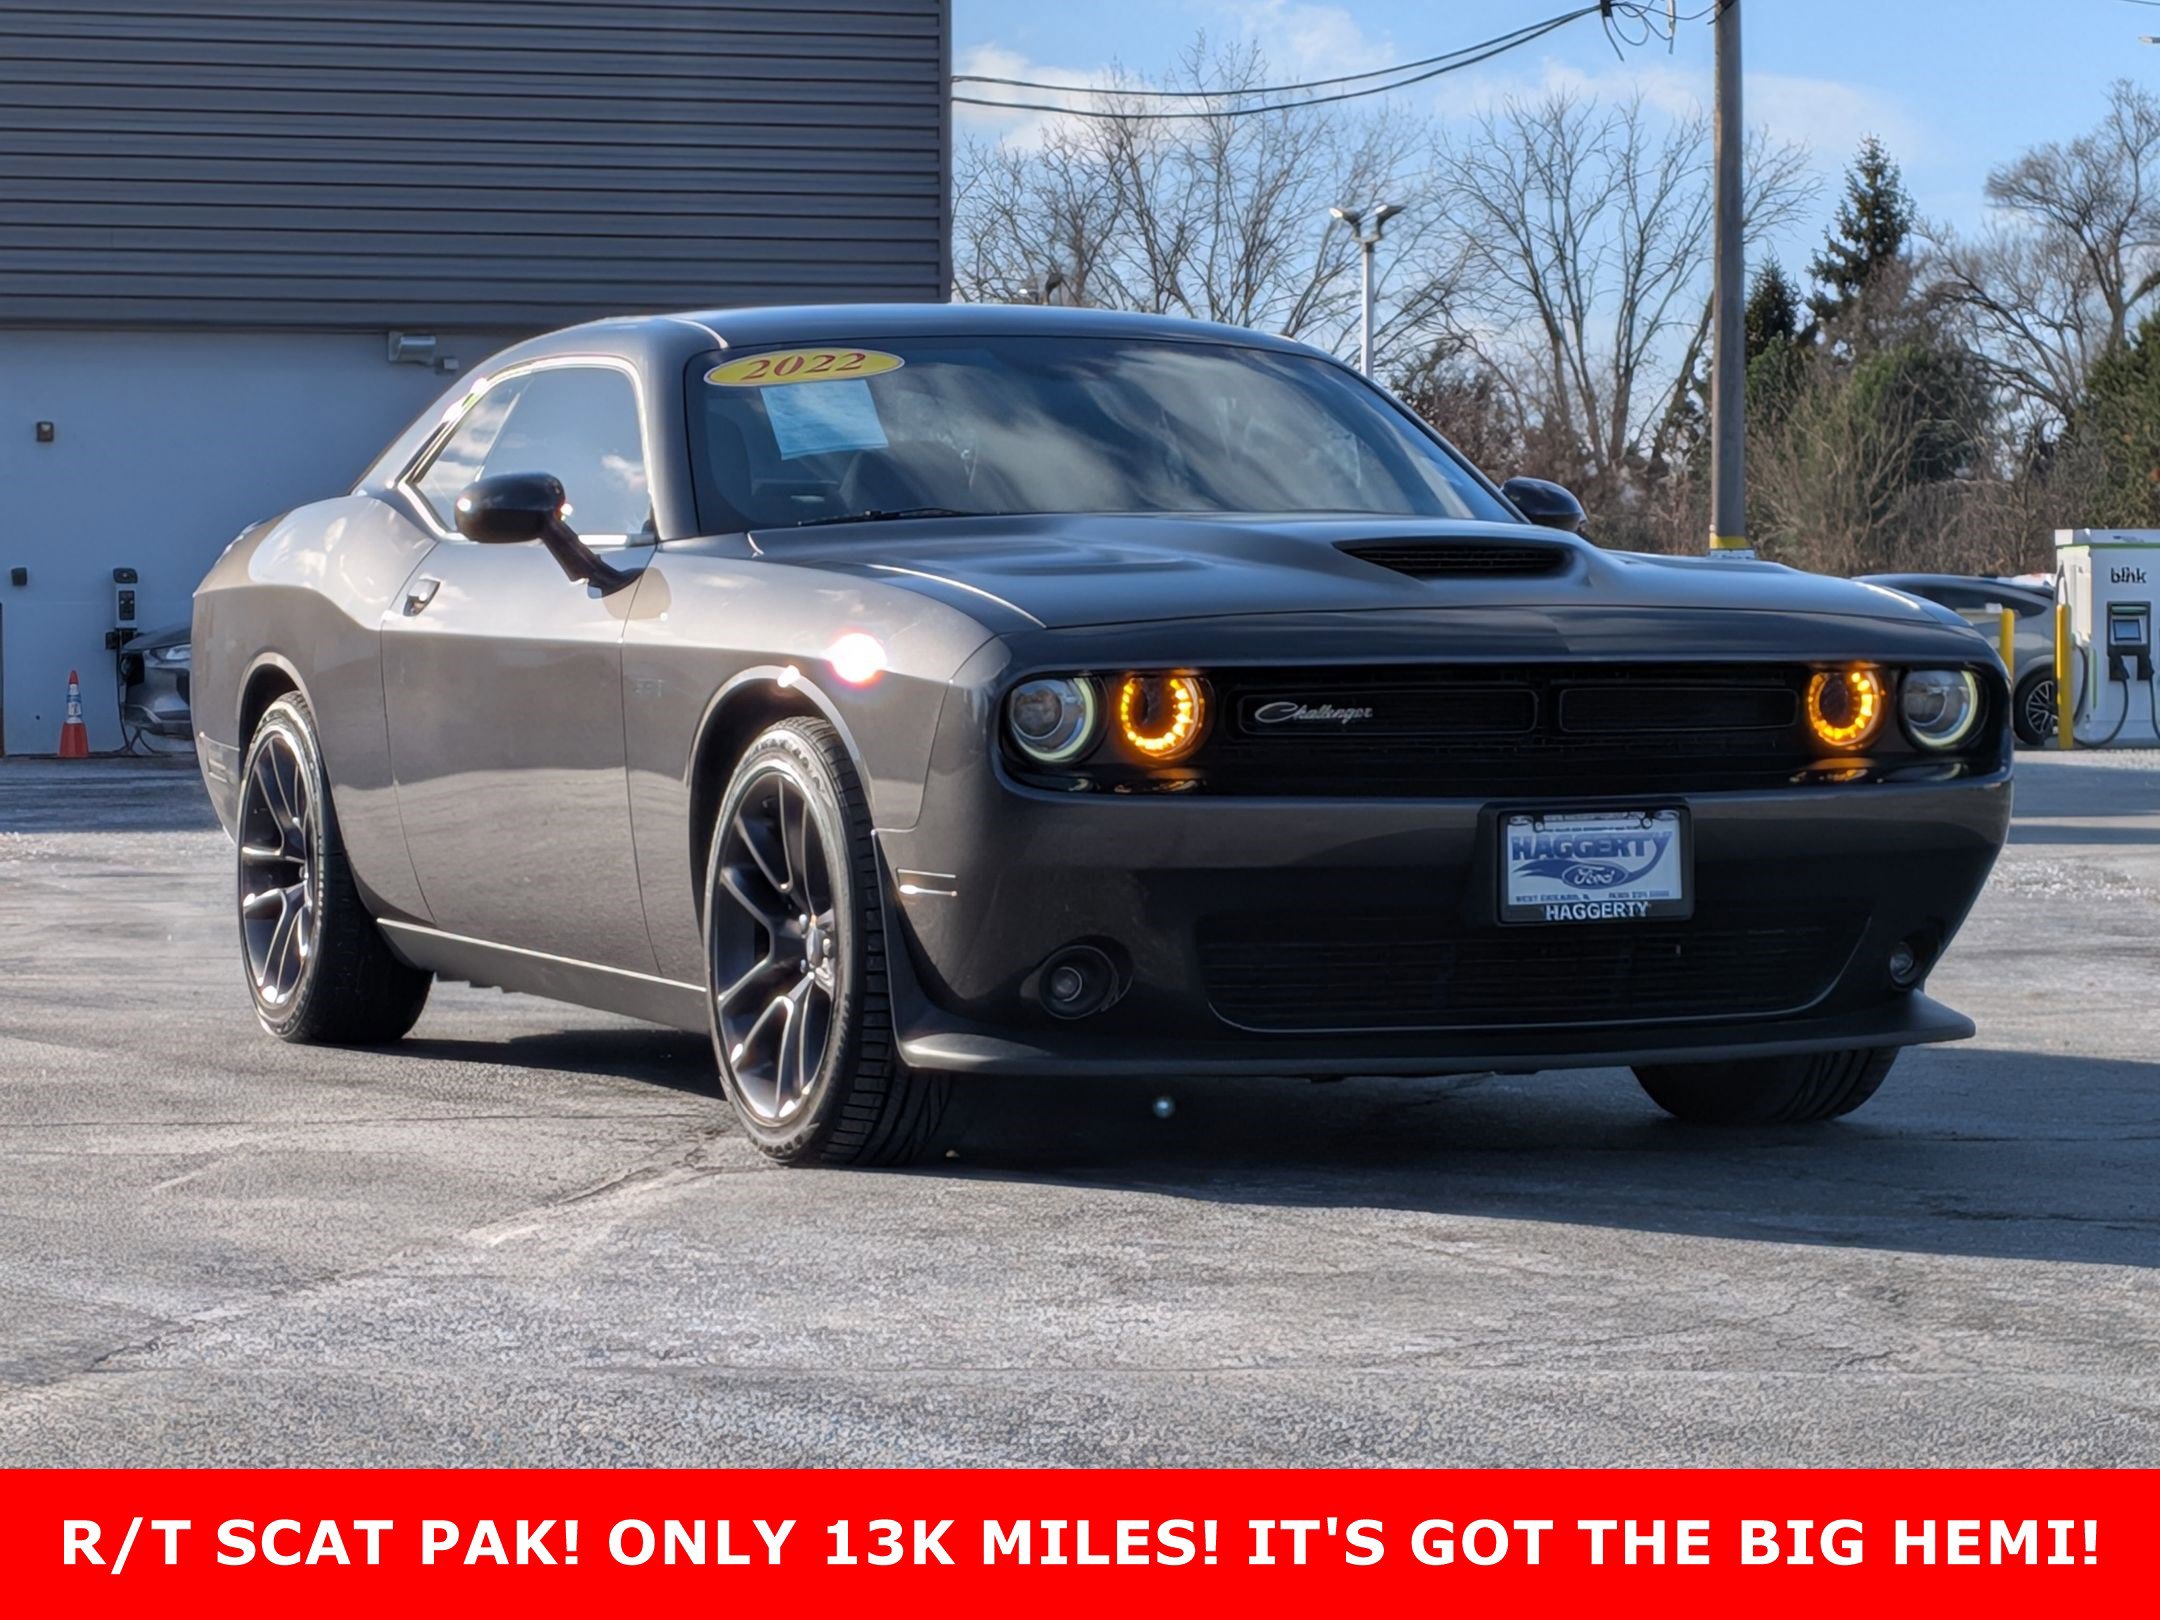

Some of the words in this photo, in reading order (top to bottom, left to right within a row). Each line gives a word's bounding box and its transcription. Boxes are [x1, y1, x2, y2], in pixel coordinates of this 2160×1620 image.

[741, 352, 867, 381] 2022
[2110, 567, 2147, 584] blink
[1254, 701, 1373, 724] Challenger
[1511, 831, 1672, 861] HAGGERTY
[1574, 866, 1615, 886] Ford
[1545, 900, 1648, 921] HAGGERTY
